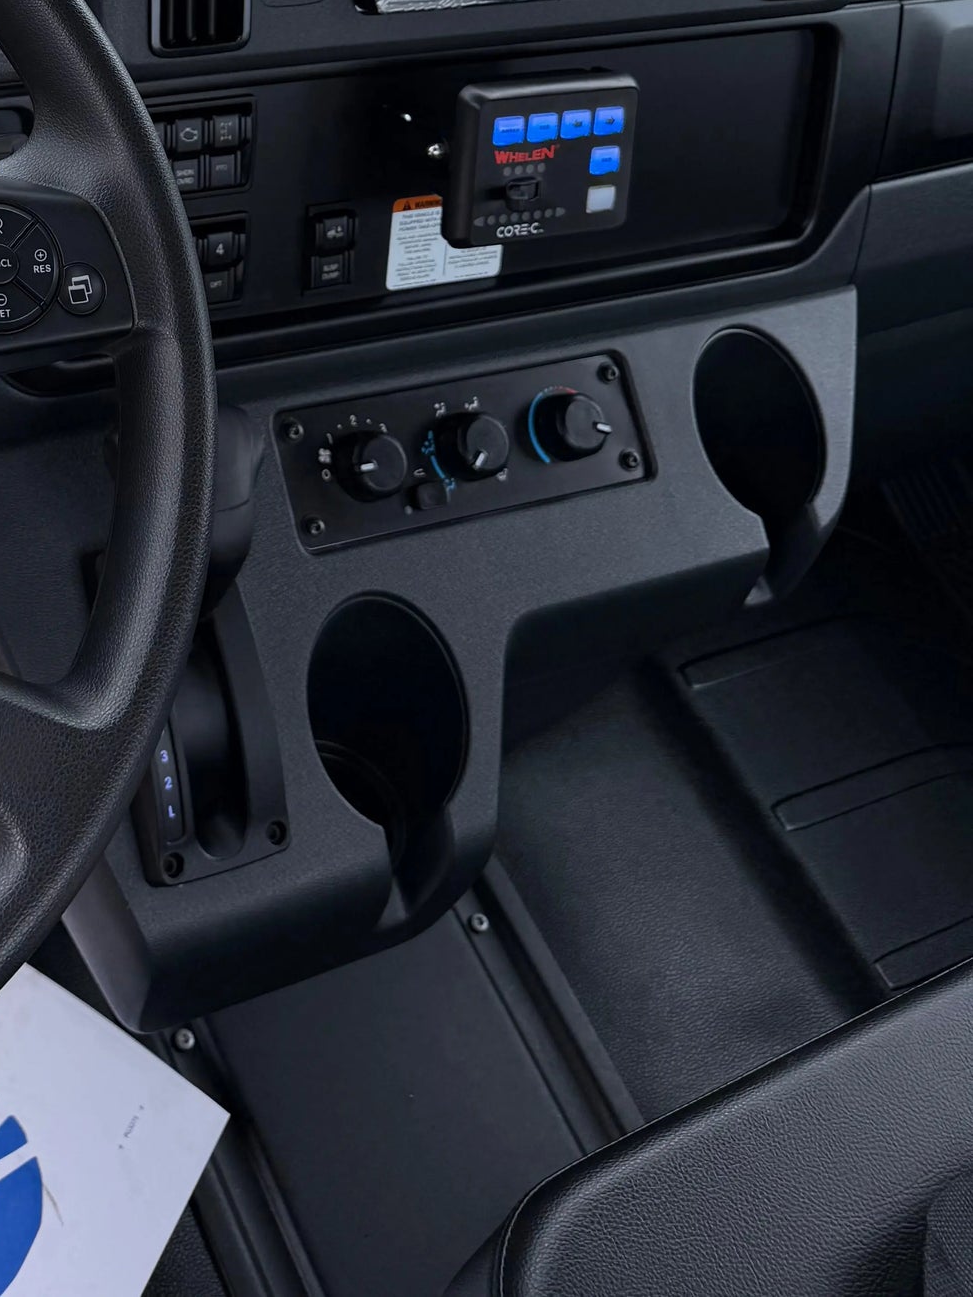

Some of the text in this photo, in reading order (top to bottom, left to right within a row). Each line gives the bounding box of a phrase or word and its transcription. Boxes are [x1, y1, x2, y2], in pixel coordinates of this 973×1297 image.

[494, 145, 555, 164] WHELEN
[215, 243, 225, 255] 4
[33, 264, 52, 274] RES
[350, 414, 357, 426] 2
[160, 750, 169, 763] 3
[164, 776, 173, 790] 2
